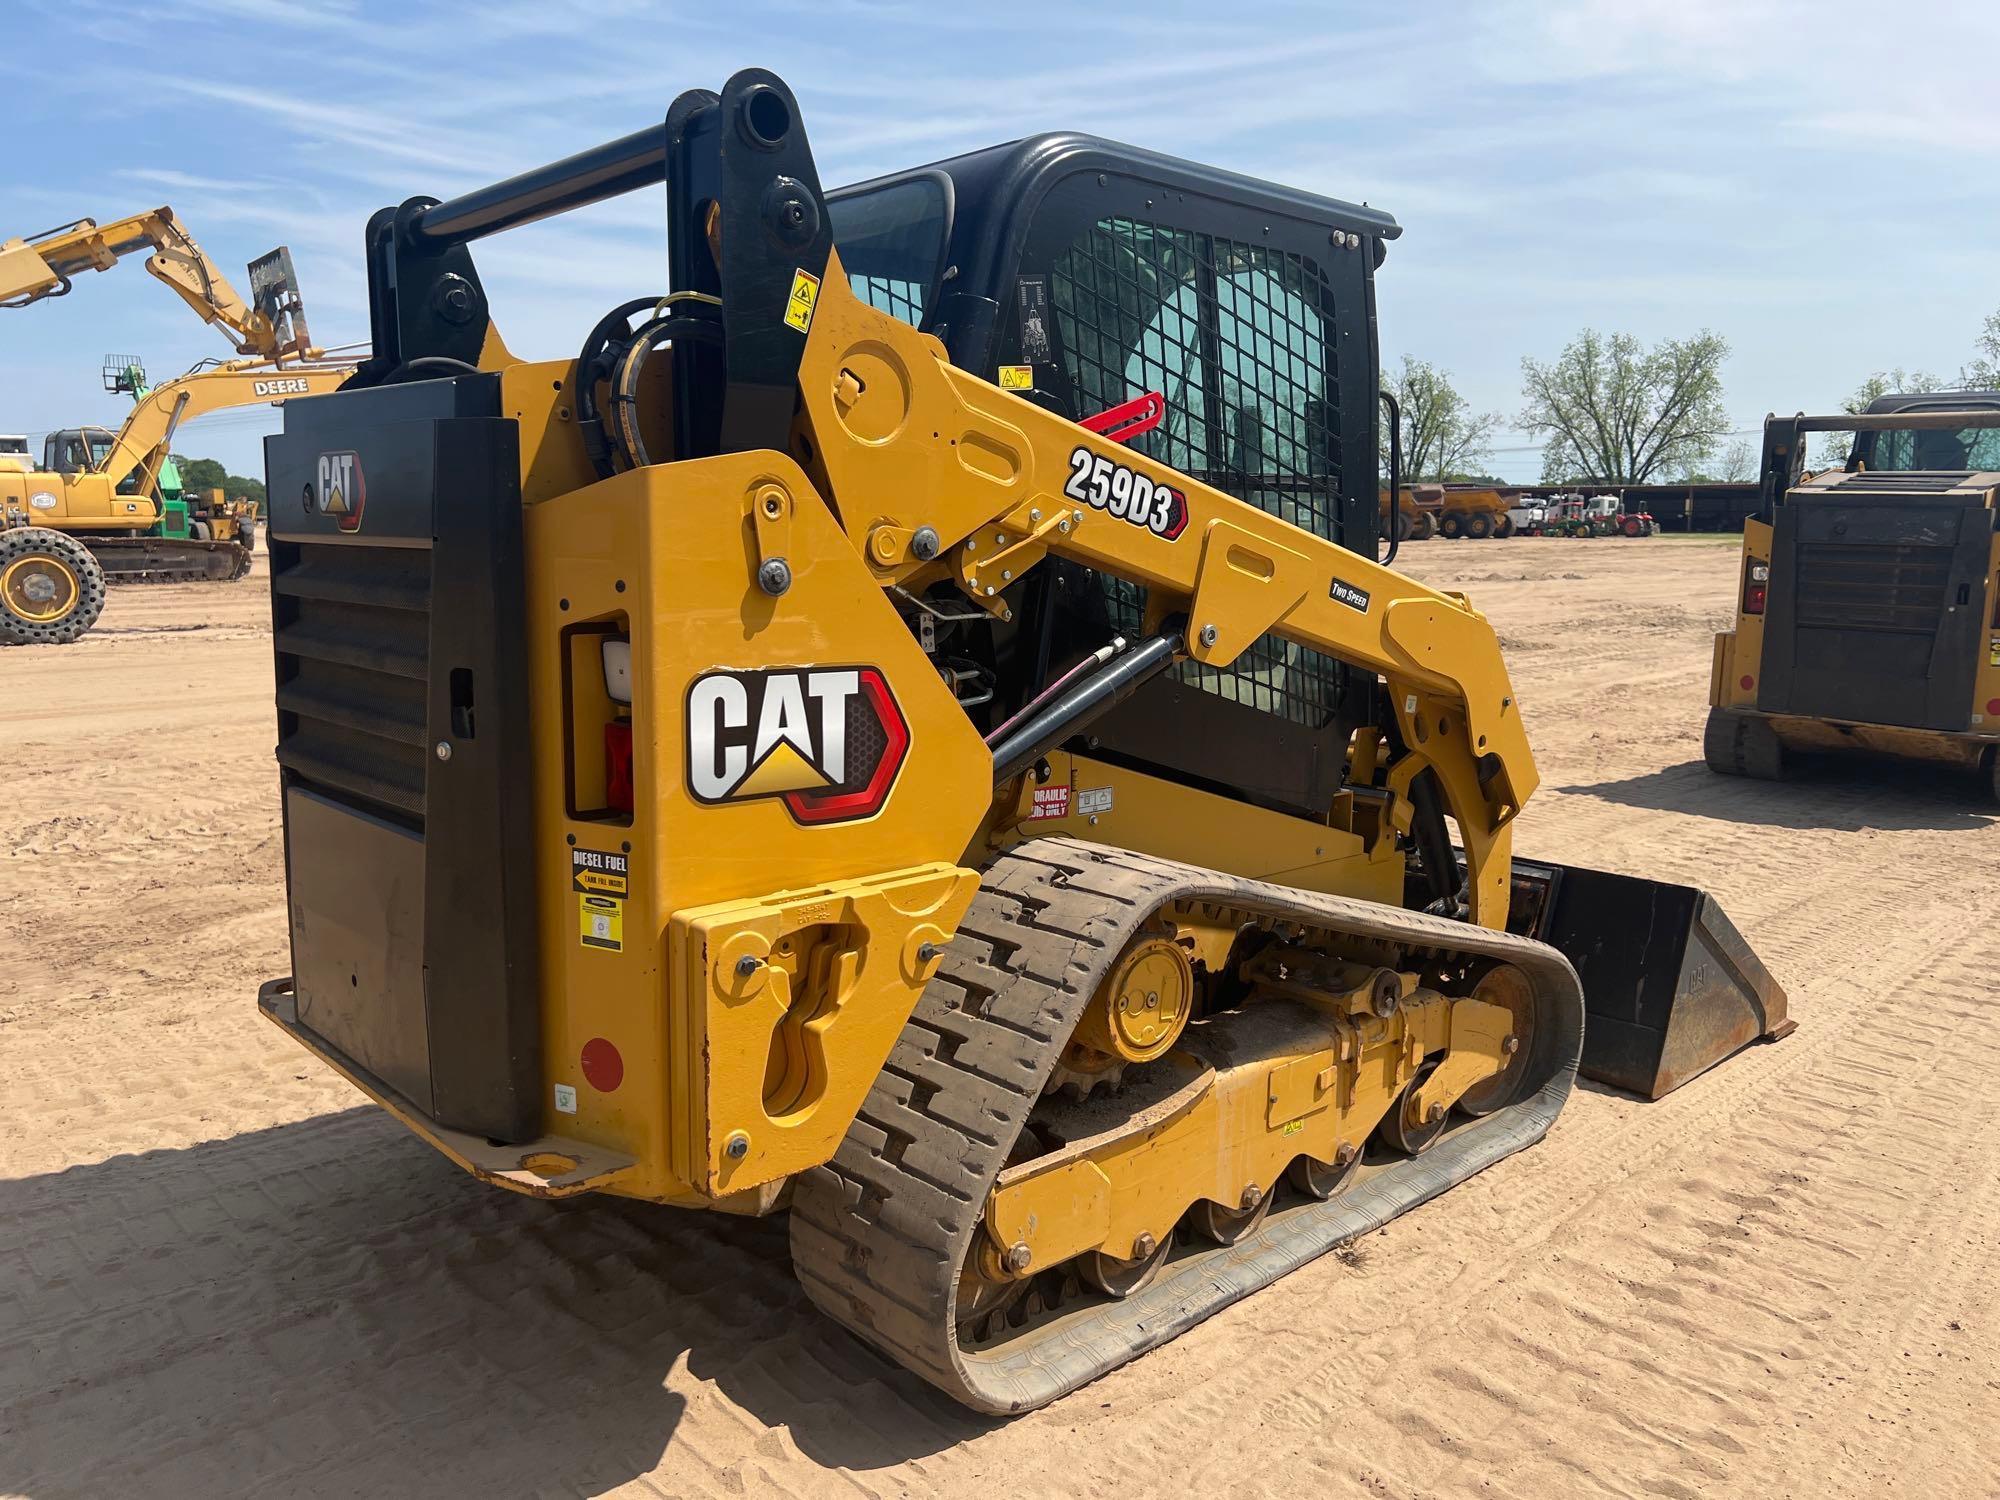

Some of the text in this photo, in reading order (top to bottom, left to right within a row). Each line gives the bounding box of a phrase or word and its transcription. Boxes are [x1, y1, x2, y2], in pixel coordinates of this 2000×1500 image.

[254, 378, 309, 396] DEERE
[318, 454, 353, 513] CAT
[1066, 448, 1173, 533] 259D3
[690, 670, 859, 799] CAT
[1045, 803, 1067, 817] ONLY
[573, 850, 627, 872] DIESEL FUEL
[584, 875, 597, 884] TANK
[608, 879, 624, 888] INSIDE
